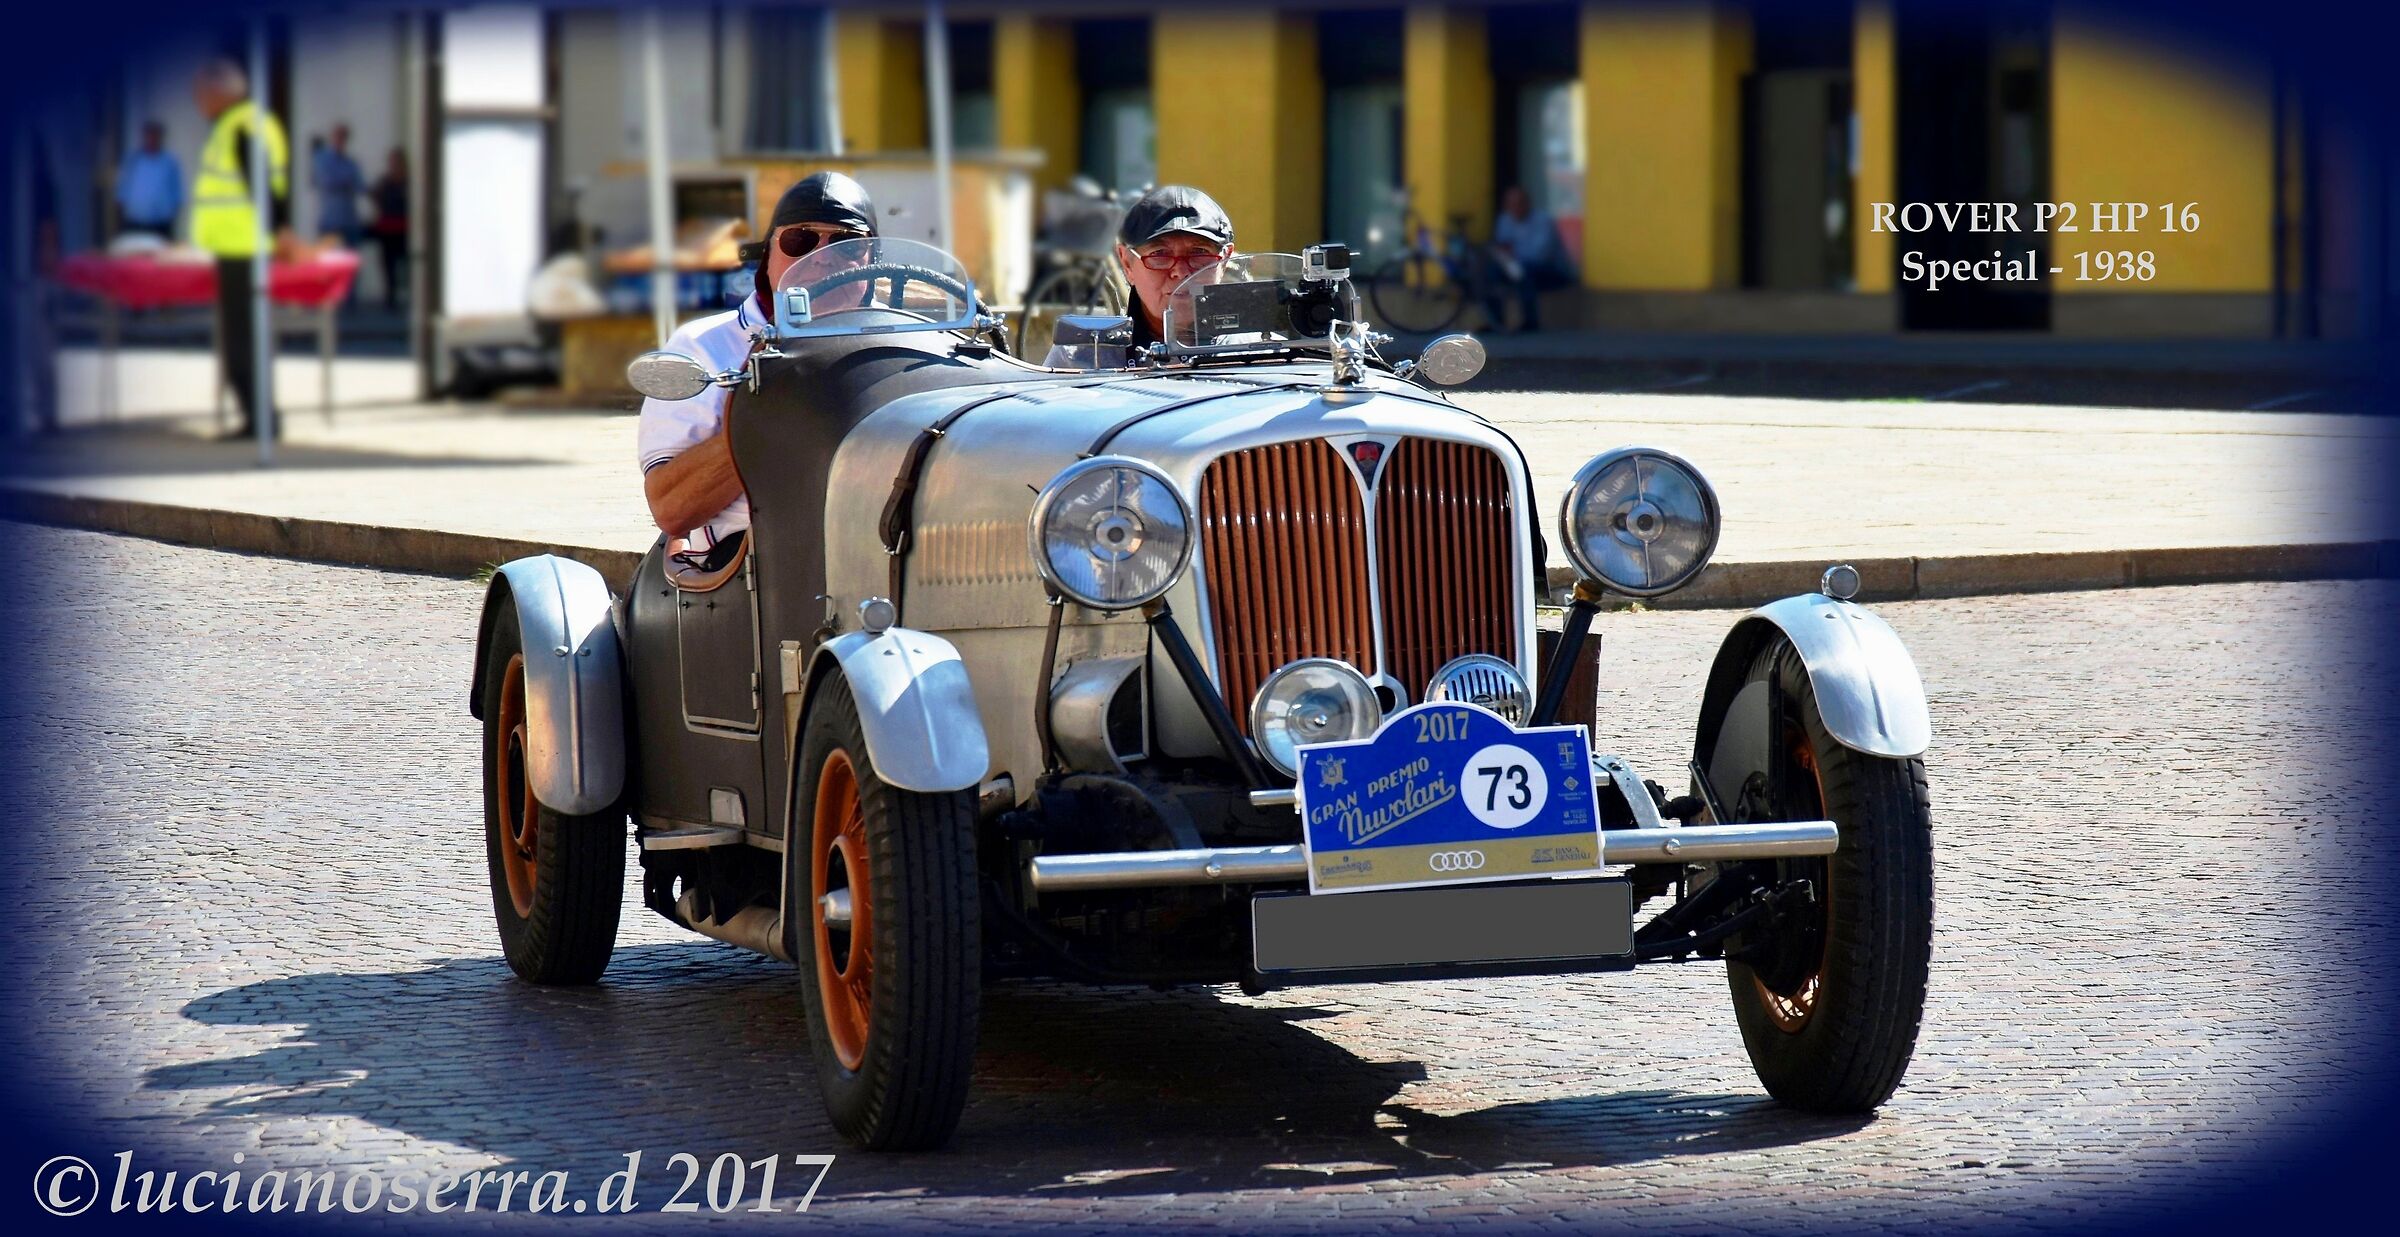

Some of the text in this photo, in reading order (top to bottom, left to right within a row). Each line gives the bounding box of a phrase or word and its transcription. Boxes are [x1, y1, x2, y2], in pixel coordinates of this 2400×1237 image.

[1413, 711, 1469, 743] 2017
[1311, 757, 1430, 825] GRAN PREMIO
[1338, 771, 1456, 842] Nuvolari
[1477, 764, 1532, 811] 73
